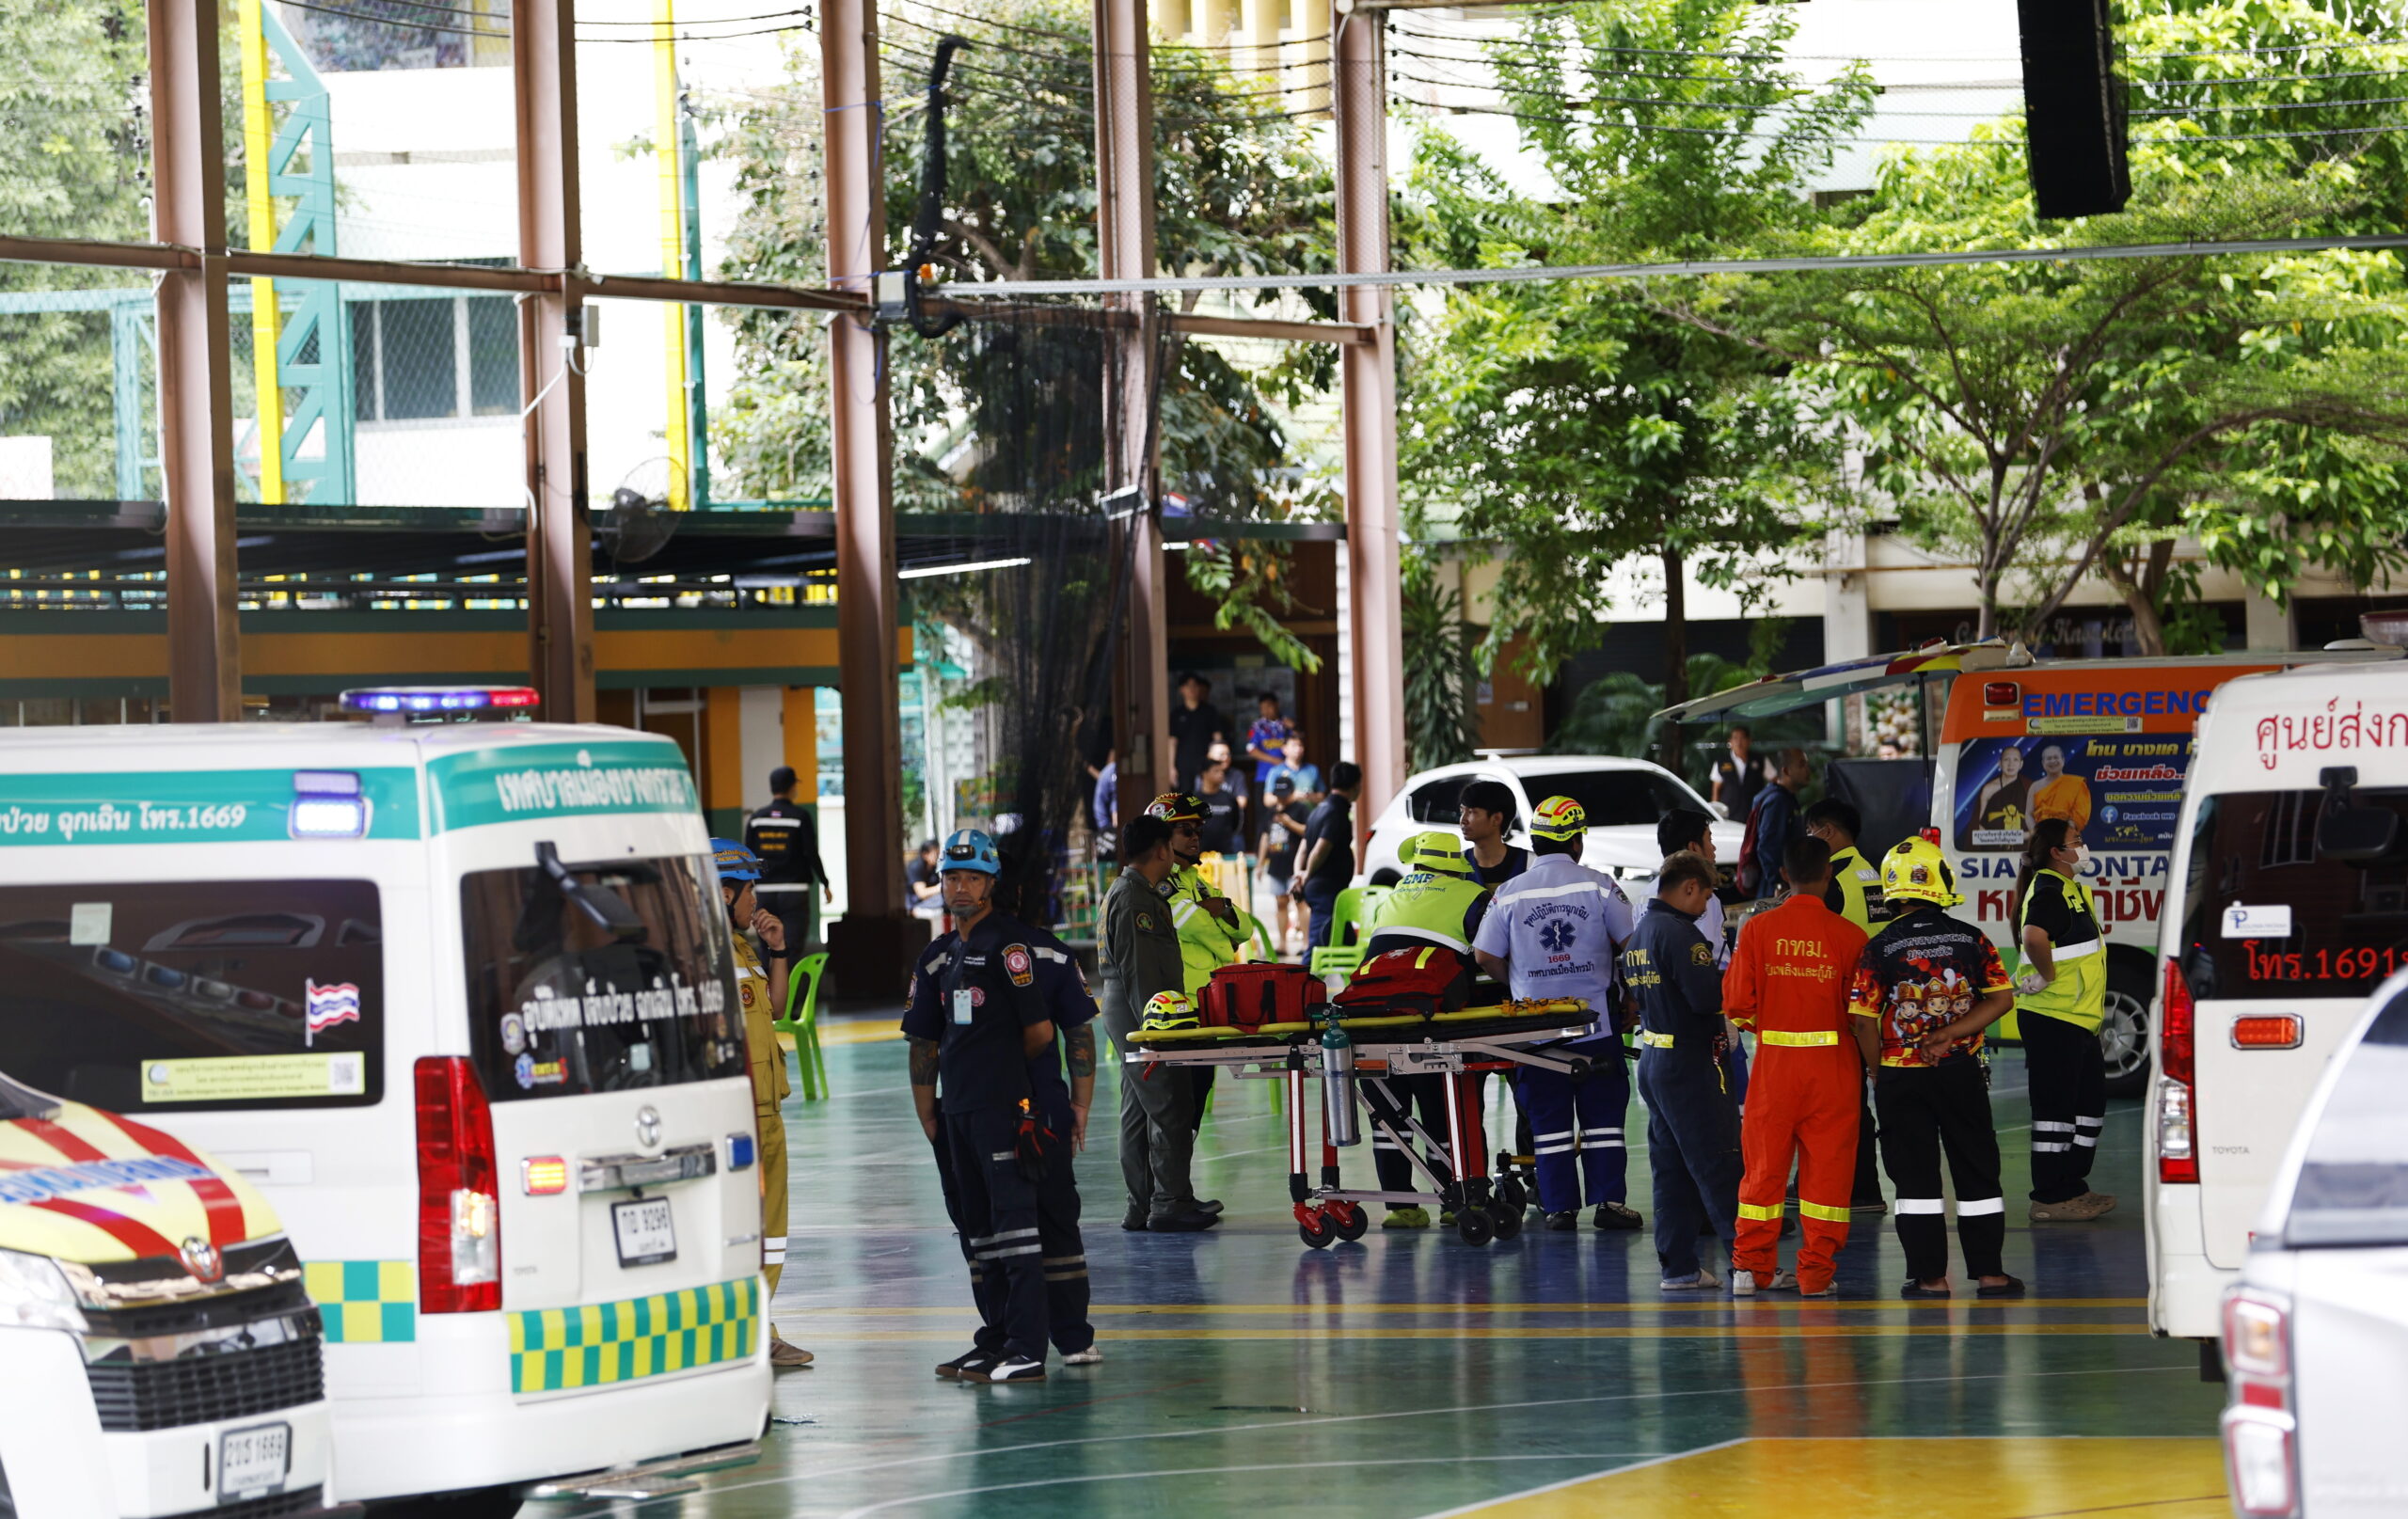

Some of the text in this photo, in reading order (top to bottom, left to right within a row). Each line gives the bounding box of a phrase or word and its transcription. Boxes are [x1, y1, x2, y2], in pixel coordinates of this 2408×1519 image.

[0, 805, 49, 833] ป่วย
[57, 803, 132, 842] ฉุกเฉิน
[1960, 857, 2023, 879] SIA
[1776, 939, 1828, 958] กทม.
[1547, 953, 1571, 964] 1669
[2211, 1145, 2251, 1156] TOYOTA
